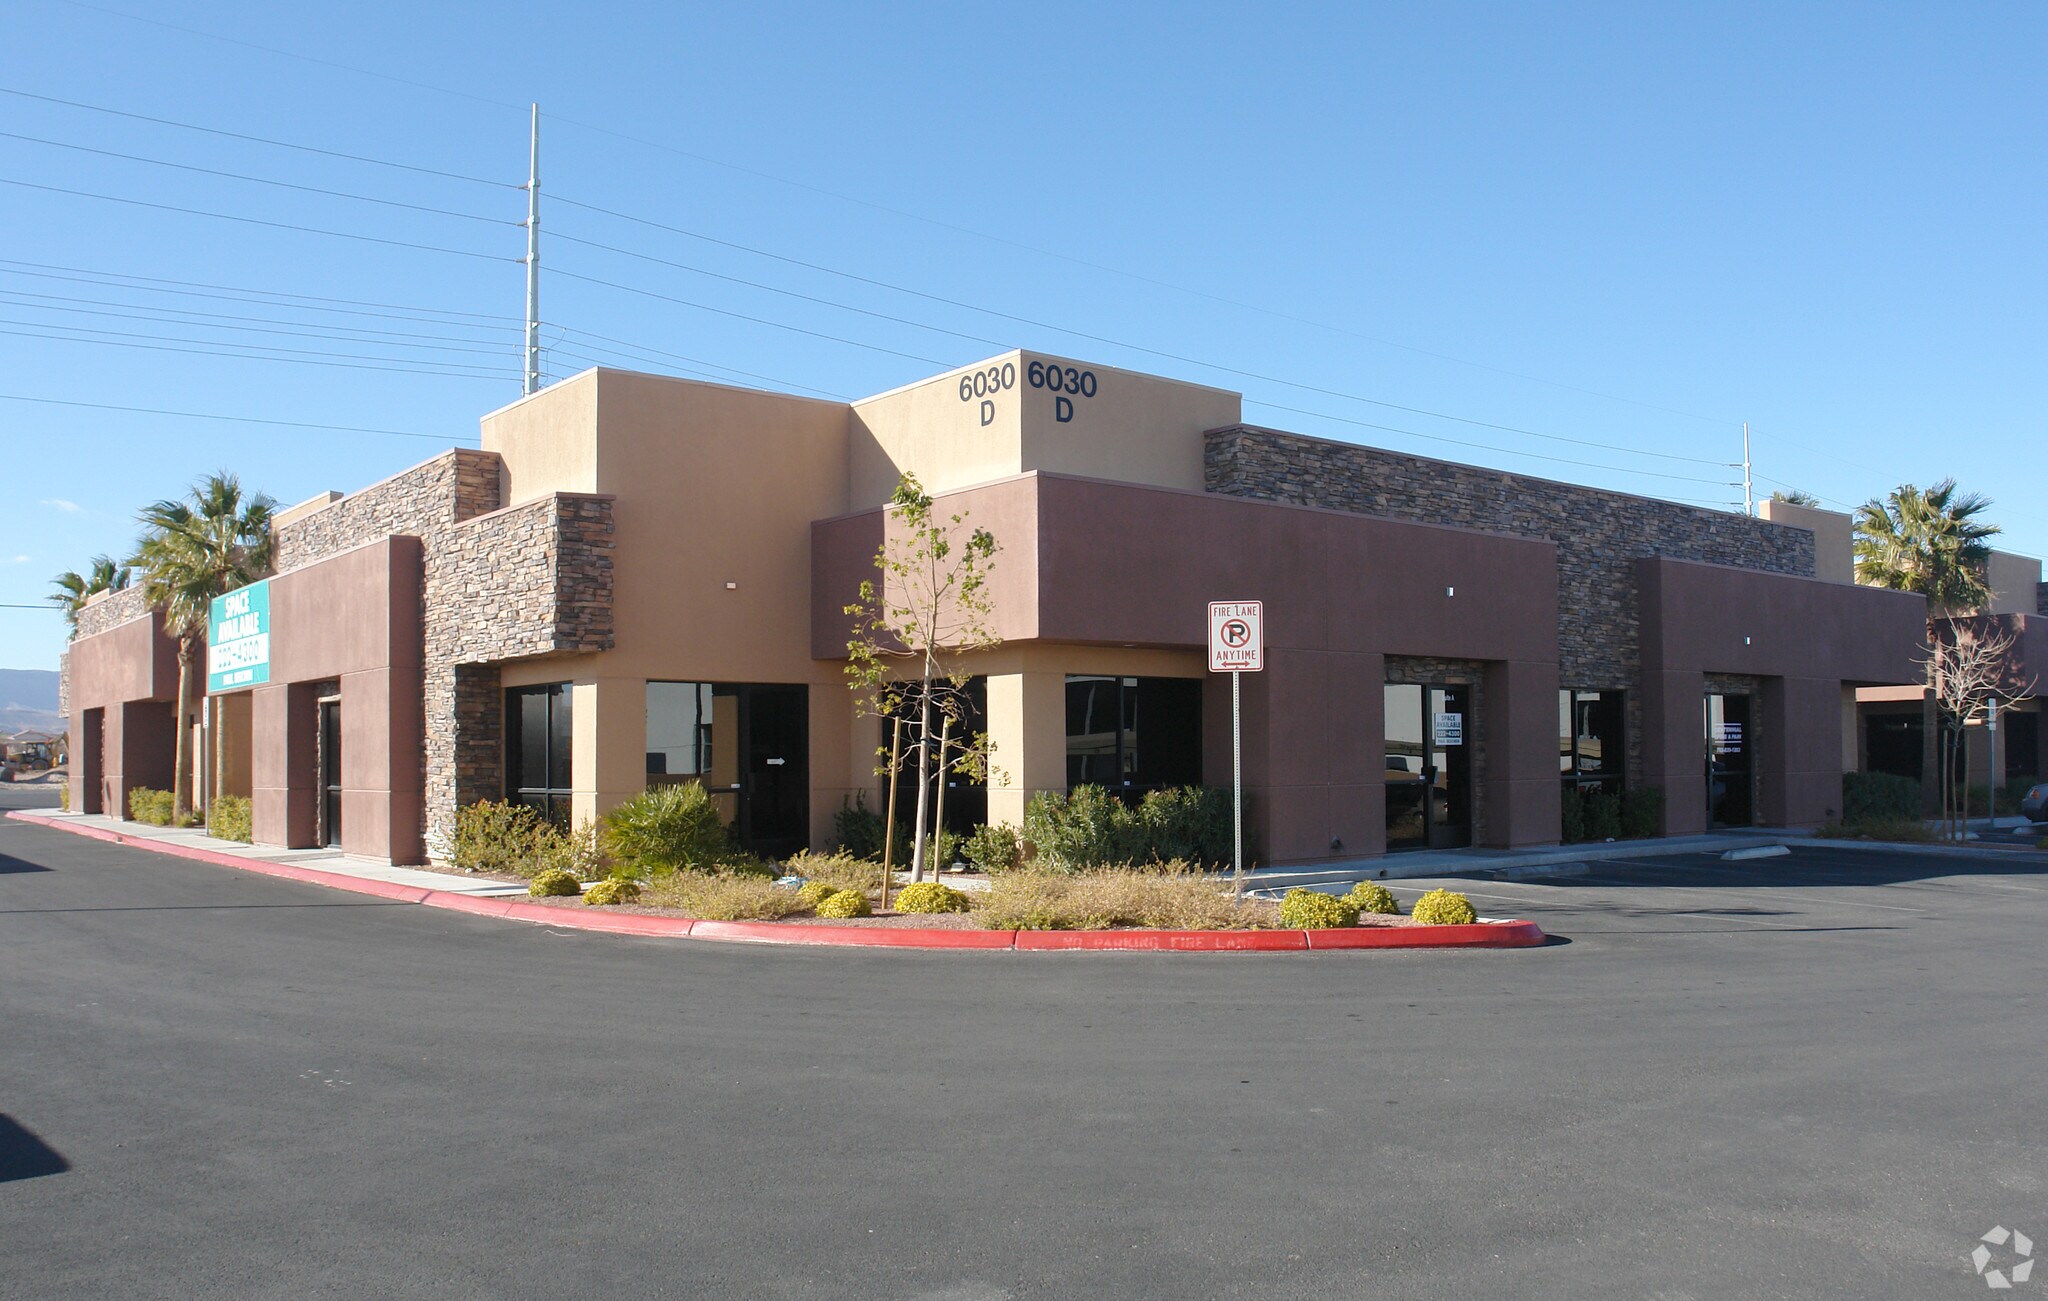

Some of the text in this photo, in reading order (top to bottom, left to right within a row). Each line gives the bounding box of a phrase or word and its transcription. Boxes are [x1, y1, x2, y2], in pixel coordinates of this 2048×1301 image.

[959, 362, 1015, 402] 6030
[1028, 361, 1097, 398] 6030
[980, 400, 995, 426] D
[1055, 396, 1074, 423] D
[225, 589, 250, 619] SPACE
[1213, 606, 1257, 616] FIRE LANE
[217, 611, 260, 644] AVAILABLE
[1216, 650, 1257, 661] ANYTIME
[1062, 936, 1083, 947] NO
[1093, 936, 1160, 948] PARKING
[1170, 936, 1204, 948] FIRE
